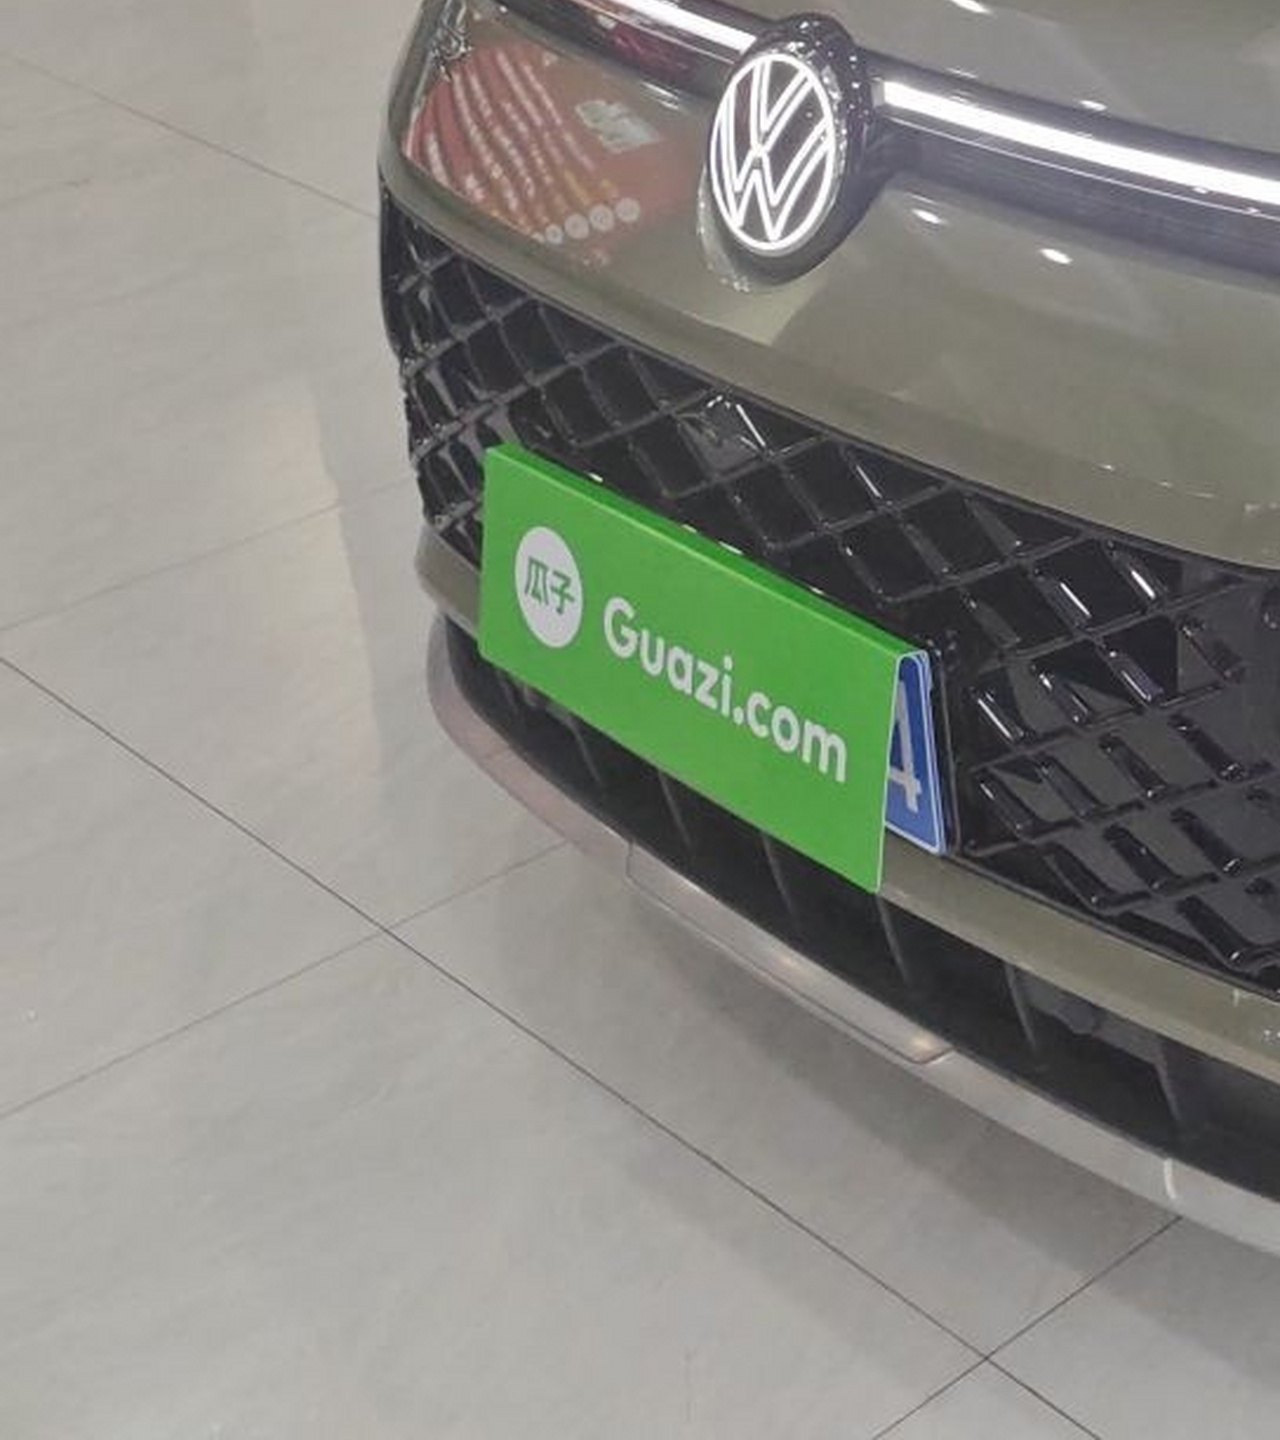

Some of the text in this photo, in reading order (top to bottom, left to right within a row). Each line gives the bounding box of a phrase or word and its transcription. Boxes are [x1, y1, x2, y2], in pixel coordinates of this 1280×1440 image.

[525, 556, 575, 615] 瓜子
[603, 596, 847, 783] Guazi.com
[888, 680, 923, 814] 4
